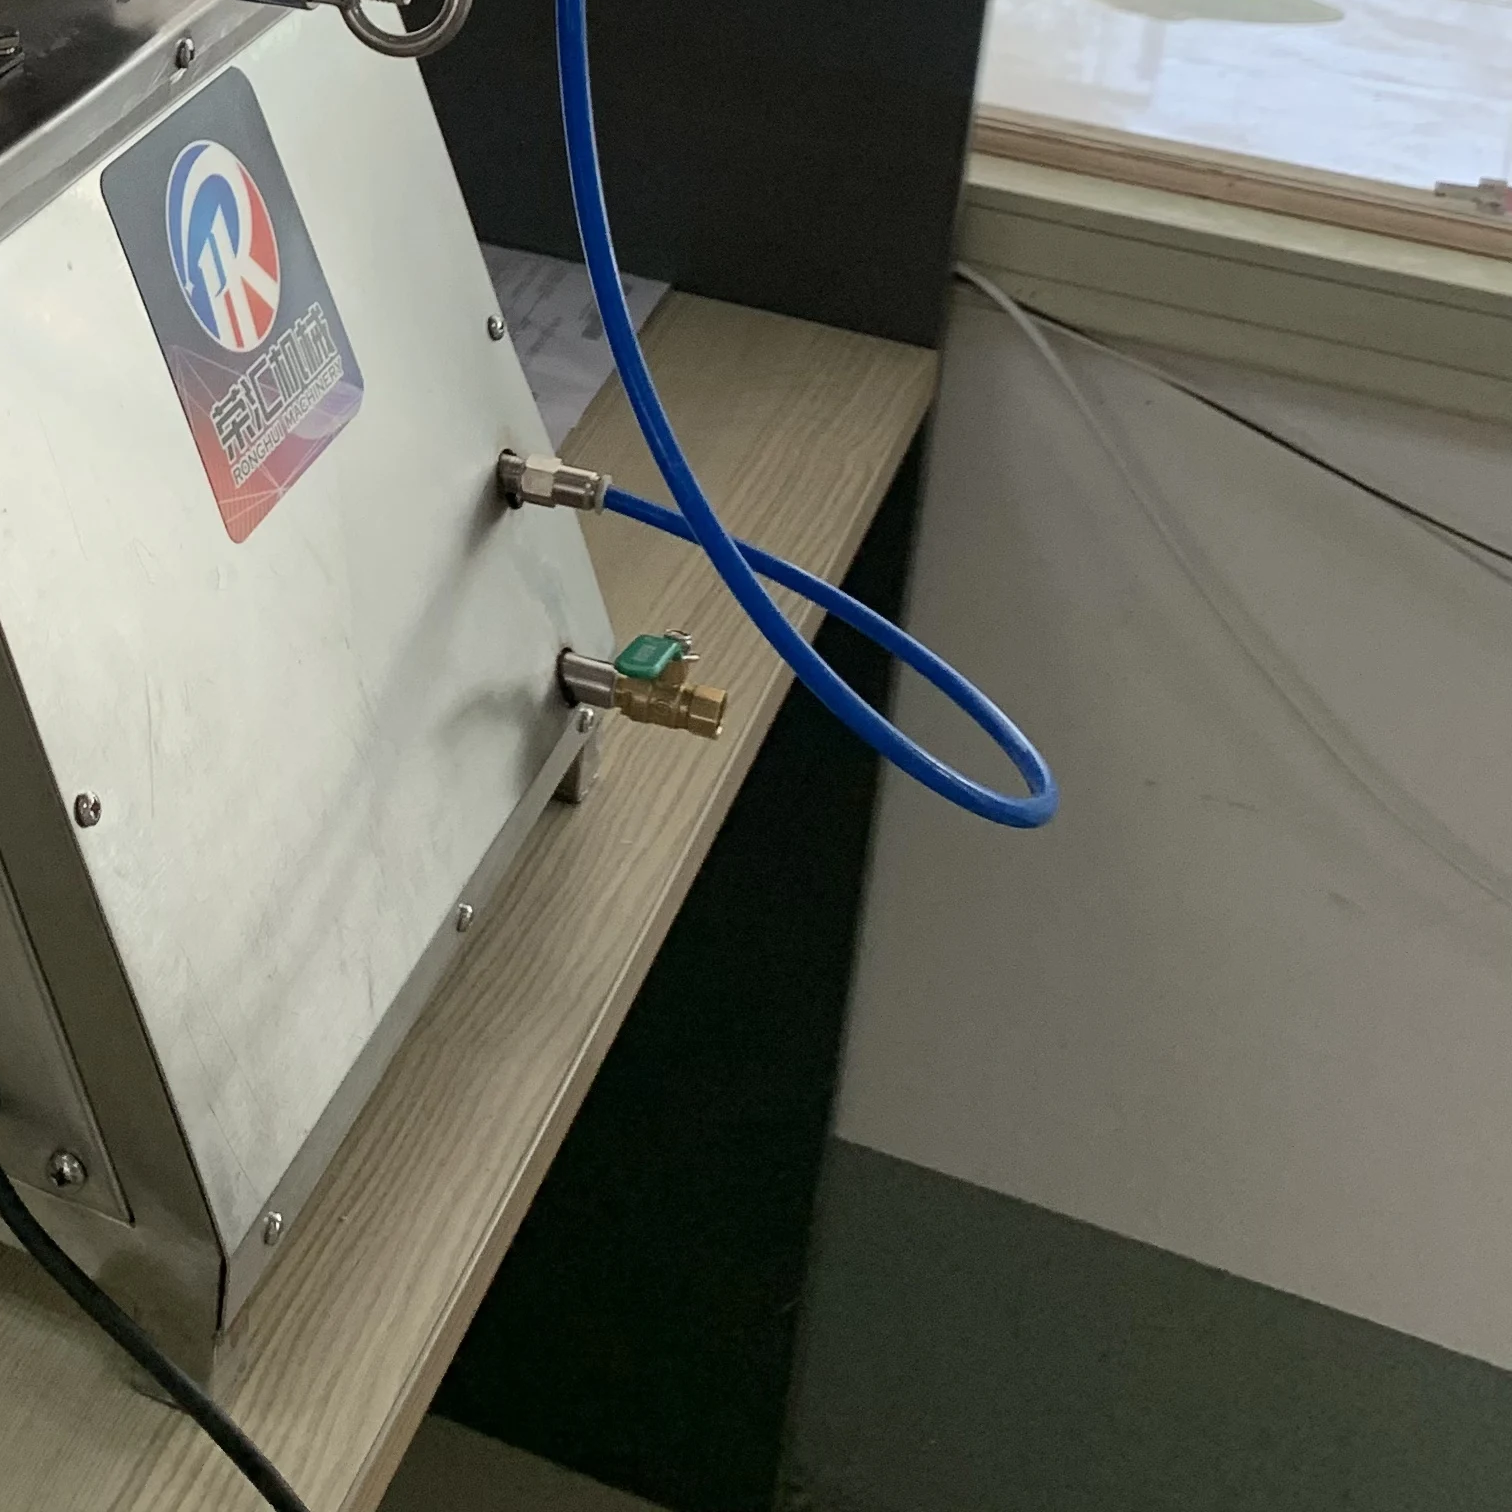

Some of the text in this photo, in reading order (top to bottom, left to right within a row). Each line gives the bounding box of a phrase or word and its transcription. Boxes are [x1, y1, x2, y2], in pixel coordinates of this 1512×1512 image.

[211, 302, 337, 464] 荣汇机械
[232, 357, 343, 485] RONGHUI MACHINERY
